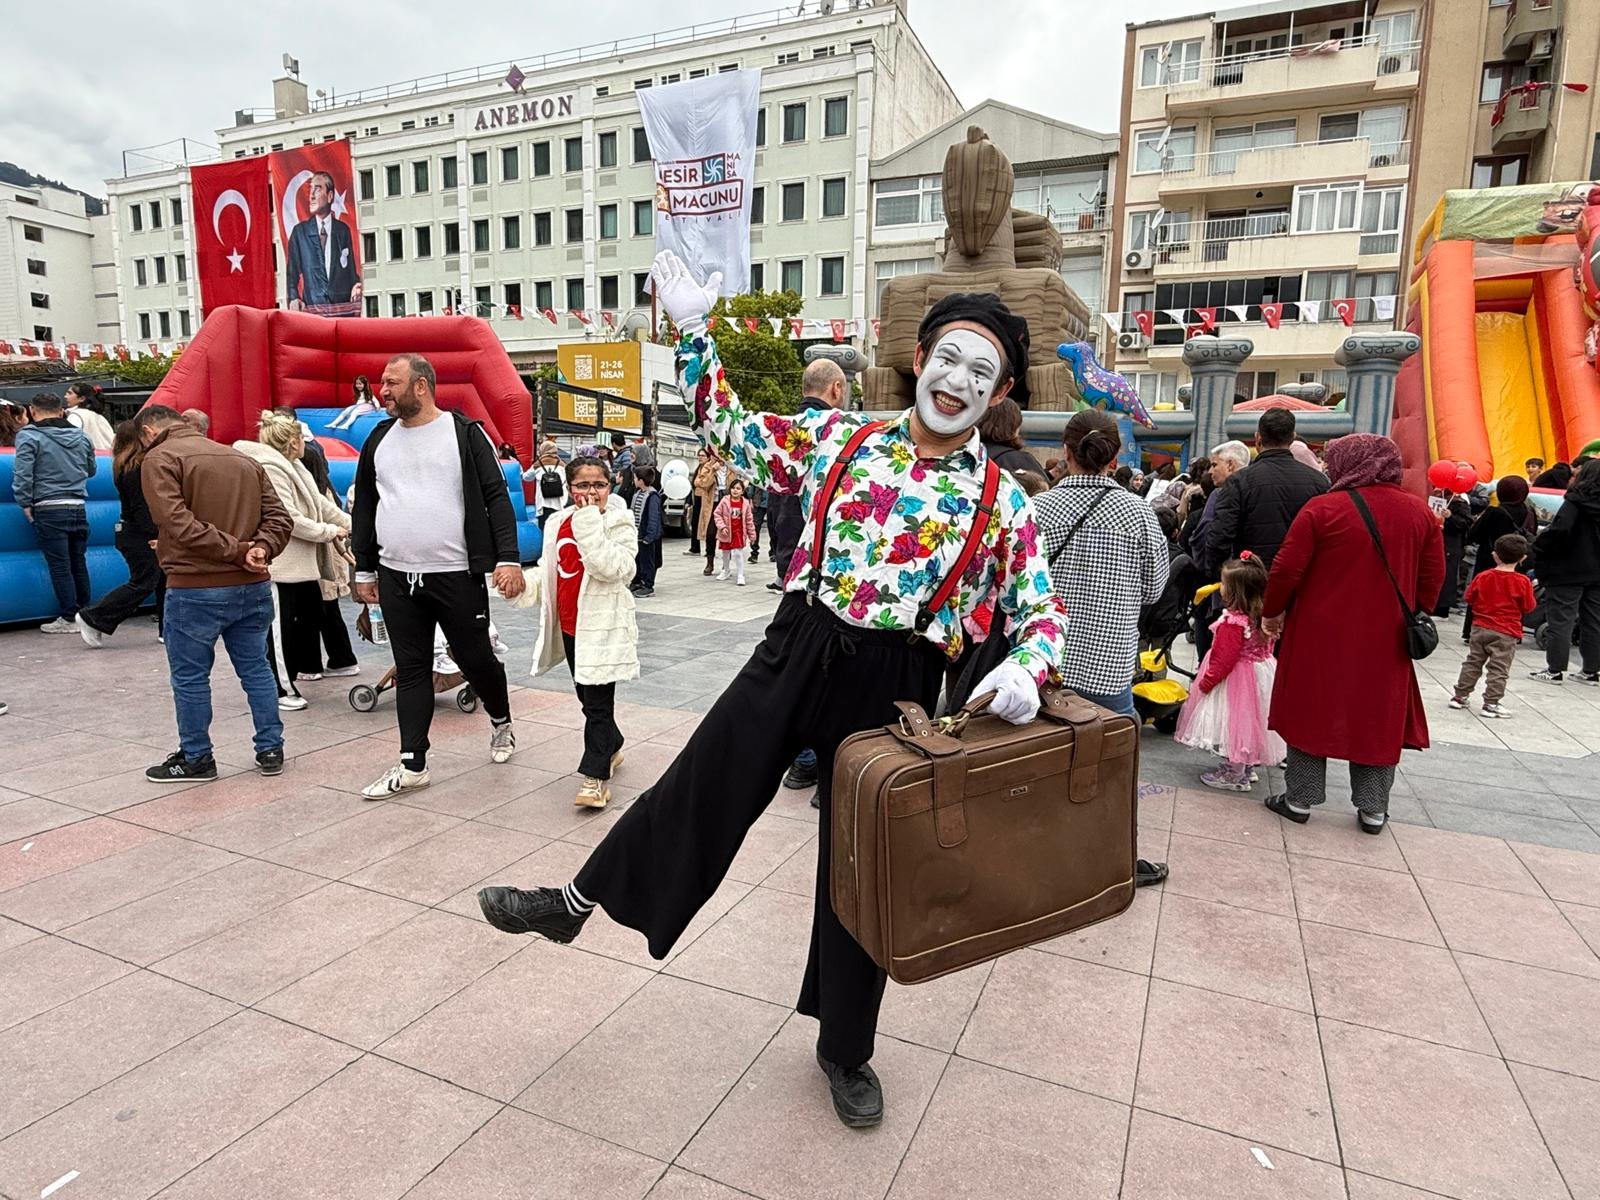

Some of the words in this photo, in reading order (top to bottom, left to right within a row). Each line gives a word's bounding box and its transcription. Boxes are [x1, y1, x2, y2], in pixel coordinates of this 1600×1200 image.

[475, 95, 573, 130] ANEMON
[660, 165, 698, 183] ESİR
[673, 187, 738, 209] MACUNU
[600, 360, 623, 369] 21-26
[600, 370, 624, 379] NİSAN
[588, 405, 624, 413] MUNU
